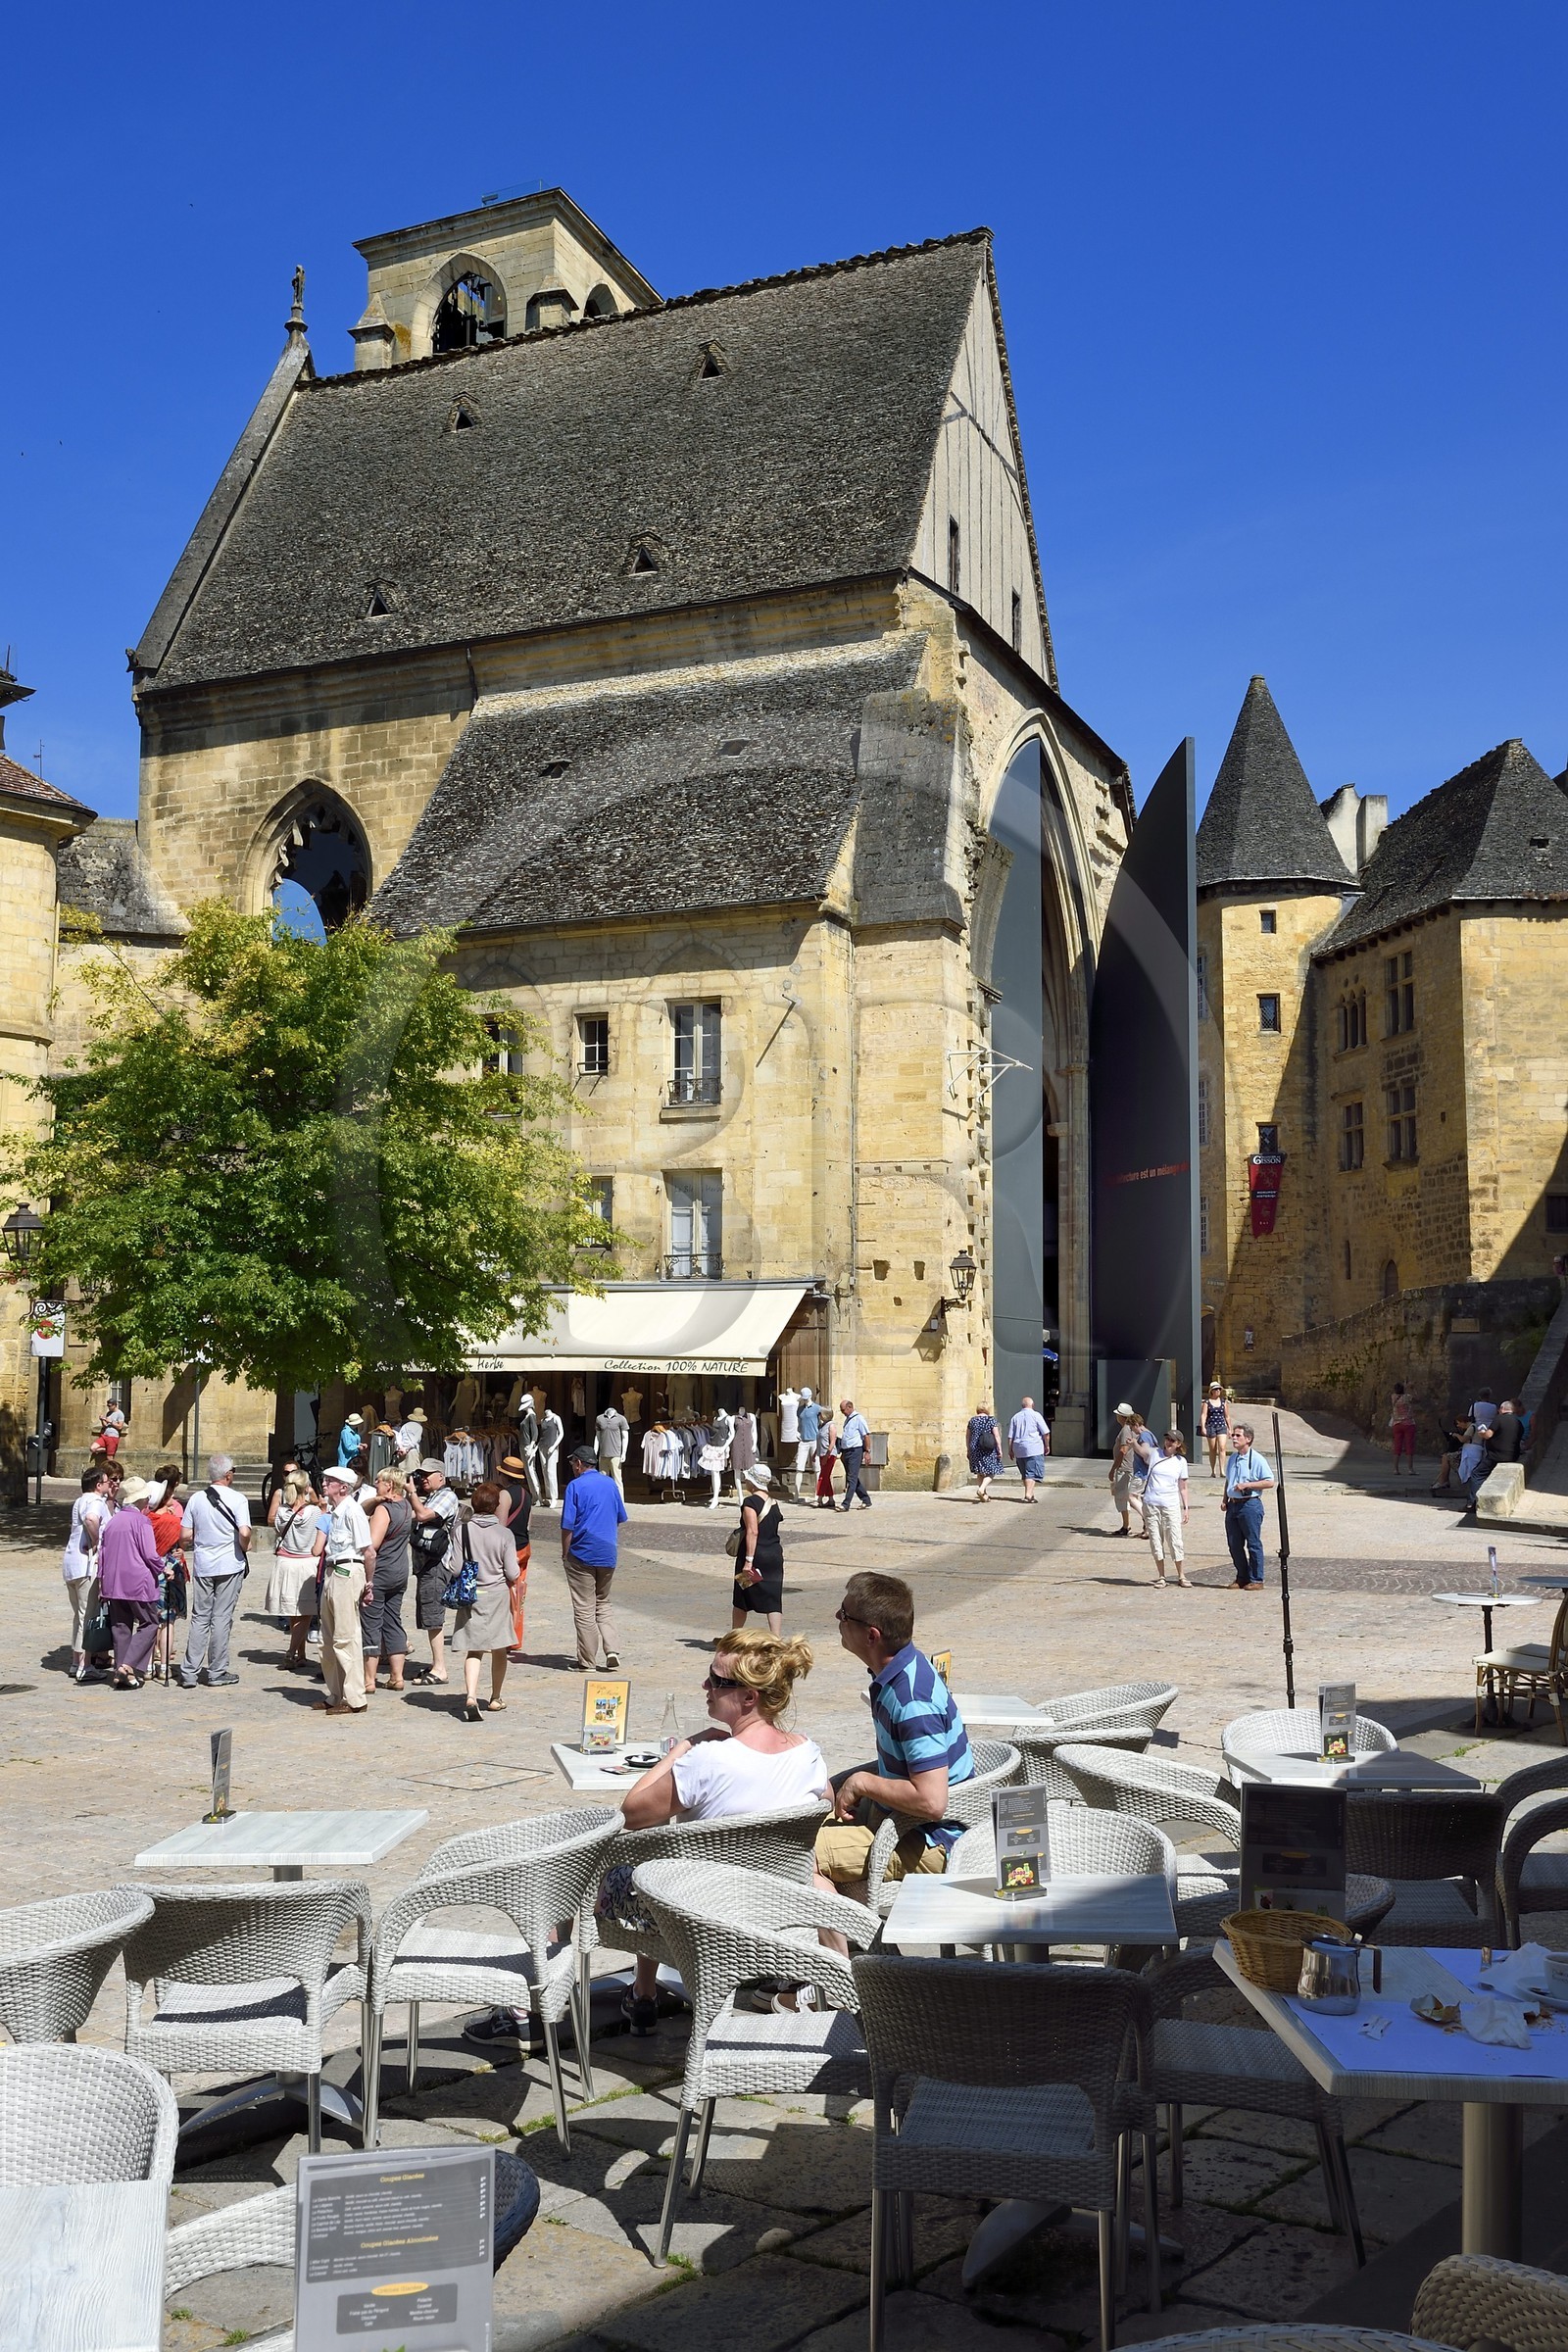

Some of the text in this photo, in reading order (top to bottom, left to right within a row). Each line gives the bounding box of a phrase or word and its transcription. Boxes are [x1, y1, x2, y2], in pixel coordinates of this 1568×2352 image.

[477, 1356, 504, 1370] Herbe
[604, 1359, 749, 1373] Collection 100% NATURE
